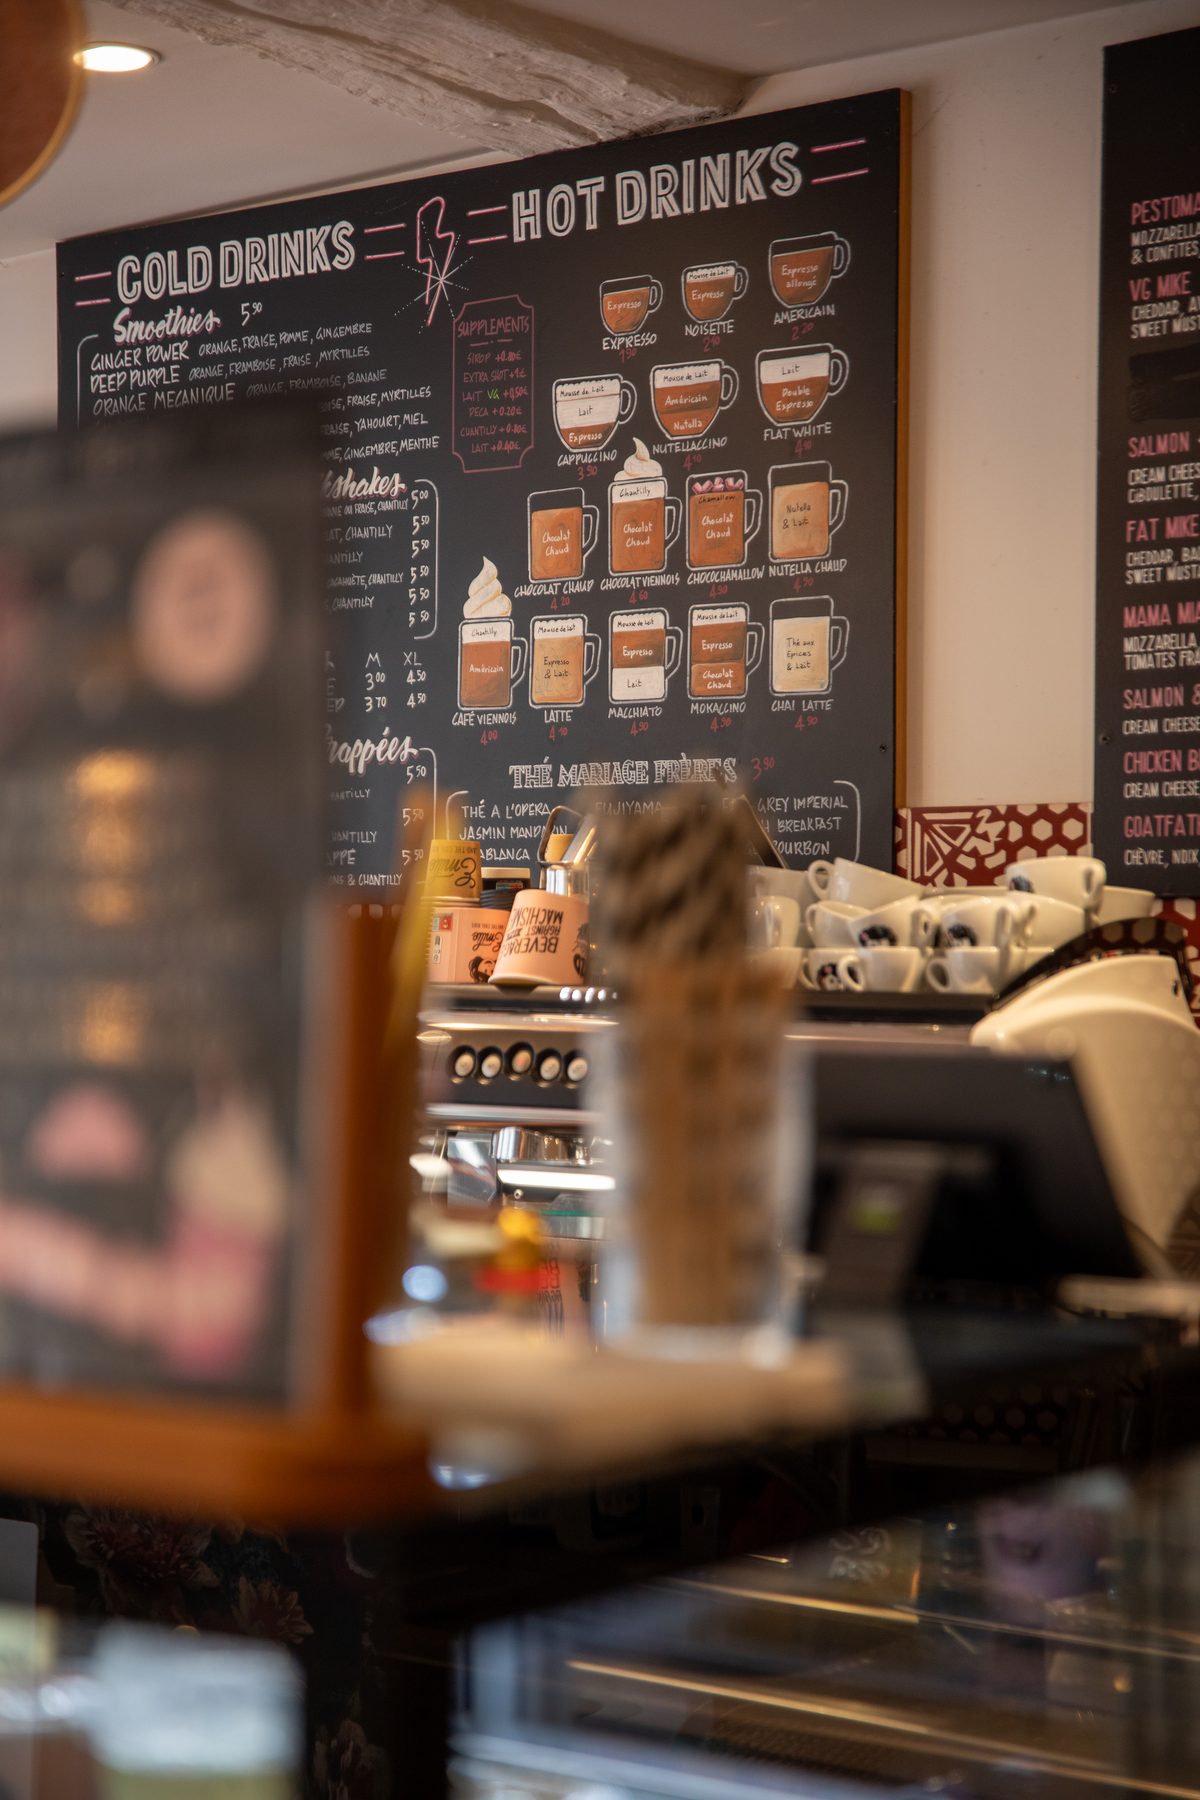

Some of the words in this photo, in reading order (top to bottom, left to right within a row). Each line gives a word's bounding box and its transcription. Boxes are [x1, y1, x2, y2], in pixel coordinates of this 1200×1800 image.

[512, 175, 605, 243] HOT
[615, 141, 802, 226] DRINKS
[117, 245, 213, 304] COLD
[219, 220, 355, 288] DRINKS
[1131, 248, 1143, 265] &
[781, 264, 819, 277] Expresso
[786, 275, 817, 289] allongé
[1129, 277, 1151, 302] VG
[1156, 271, 1191, 298] MIKE
[691, 290, 725, 302] Expresso
[607, 300, 642, 313] Expresso
[773, 304, 836, 325] AMERICAIN
[112, 305, 221, 346] Smoothies
[457, 315, 529, 338] SUPPLEMENTS
[684, 319, 735, 337] NOISETTE
[1131, 319, 1169, 339] SWEET
[91, 347, 142, 371] GINGER
[146, 340, 190, 363] POWER
[315, 323, 373, 341] GINGEMBRE
[602, 332, 657, 351] EXPRESSO
[467, 352, 491, 365] SIROP
[90, 371, 127, 394] DEEP
[130, 365, 181, 390] PURPLE
[319, 346, 370, 362] MYRTILLES
[463, 371, 489, 383] EXTRA
[782, 364, 801, 375] Lait
[93, 392, 147, 416] ORANGE
[153, 382, 236, 409] MECANIQUE
[347, 369, 387, 384] BANANE
[380, 386, 431, 402] MYRTILLES
[462, 390, 483, 402] LAIT
[487, 388, 500, 400] VG
[782, 385, 811, 397] Double
[664, 394, 708, 407] Américain
[776, 400, 814, 413] Expresso
[402, 412, 429, 425] MIEL
[469, 406, 489, 417] DECA
[578, 405, 593, 417] Lait
[460, 424, 497, 437] CHANTILLY
[673, 417, 703, 431] Nutella
[763, 427, 790, 441] FLAT
[793, 421, 832, 438] WHITE
[399, 436, 440, 452] MENTHE
[568, 432, 603, 445] Expresso
[652, 436, 728, 454] NUTELLACCINO
[1128, 431, 1190, 458] SALMON
[471, 442, 489, 454] LAIT
[557, 449, 618, 467] CAPPUCCINO
[1128, 466, 1166, 486] CREAM
[619, 487, 651, 498] Chantilly
[698, 493, 736, 504] Chamallow
[786, 502, 811, 514] Nutella
[701, 512, 734, 526] Chocolat
[782, 518, 789, 530] &
[793, 518, 809, 527] Lait
[345, 524, 393, 541] CHANTILLY
[623, 520, 653, 534] Chocolat
[705, 527, 731, 540] Chaud
[1126, 517, 1160, 543] FAT
[1165, 514, 1200, 539] MIKE
[542, 529, 571, 543] Chocolat
[625, 537, 650, 548] Chaud
[545, 545, 569, 557] Chaud
[687, 564, 765, 585] CHOCOCHAMALLOW
[769, 561, 812, 578] NUTELLA
[814, 558, 848, 573] CHAUD
[1125, 566, 1163, 585] SWEET
[368, 572, 404, 586] CHANTILLY
[600, 576, 642, 591] CHOCOLAT
[642, 572, 680, 588] VIENNOIS
[514, 582, 561, 598] CHOCOLAT
[563, 579, 594, 594] CHAUD
[1123, 603, 1172, 629] MAMA
[701, 640, 733, 652] Expresso
[786, 637, 800, 647] Thé
[365, 652, 381, 668] M
[403, 651, 422, 666] XL
[622, 645, 653, 659] Expresso
[543, 656, 570, 667] Expresso
[786, 662, 793, 671] &
[796, 661, 811, 670] Lait
[1123, 651, 1177, 671] TOMATES
[544, 670, 551, 679] &
[553, 669, 569, 678] Lait
[702, 668, 734, 679] Chocolat
[627, 679, 642, 689] Lait
[706, 679, 732, 689] Chaud
[1123, 685, 1184, 710] SALMON
[608, 705, 663, 719] MACCHIATO
[690, 701, 747, 716] MOKACCINO
[771, 699, 796, 712] CHAI
[802, 699, 834, 711] LATTE
[451, 710, 475, 726] CAFÉ
[476, 711, 517, 726] VIENNOIS
[544, 709, 573, 724] LATTE
[1122, 718, 1158, 735] CREAM
[326, 724, 419, 776] rappées
[1123, 749, 1182, 774] CHICKEN
[508, 756, 553, 789] THÉ
[557, 759, 649, 787] MARIAGE
[653, 752, 737, 784] FRÈRES
[1123, 782, 1159, 798] CREAM
[461, 799, 486, 819] THÉ
[491, 805, 501, 818] A
[506, 802, 551, 819] L'OPERA
[595, 800, 663, 816] FUJIYAMA
[757, 797, 790, 814] GREY
[793, 795, 849, 811] IMPERIAL
[777, 816, 842, 833] BREAKFAST
[458, 825, 505, 840] JASMIN
[358, 873, 403, 886] CHANTILLY
